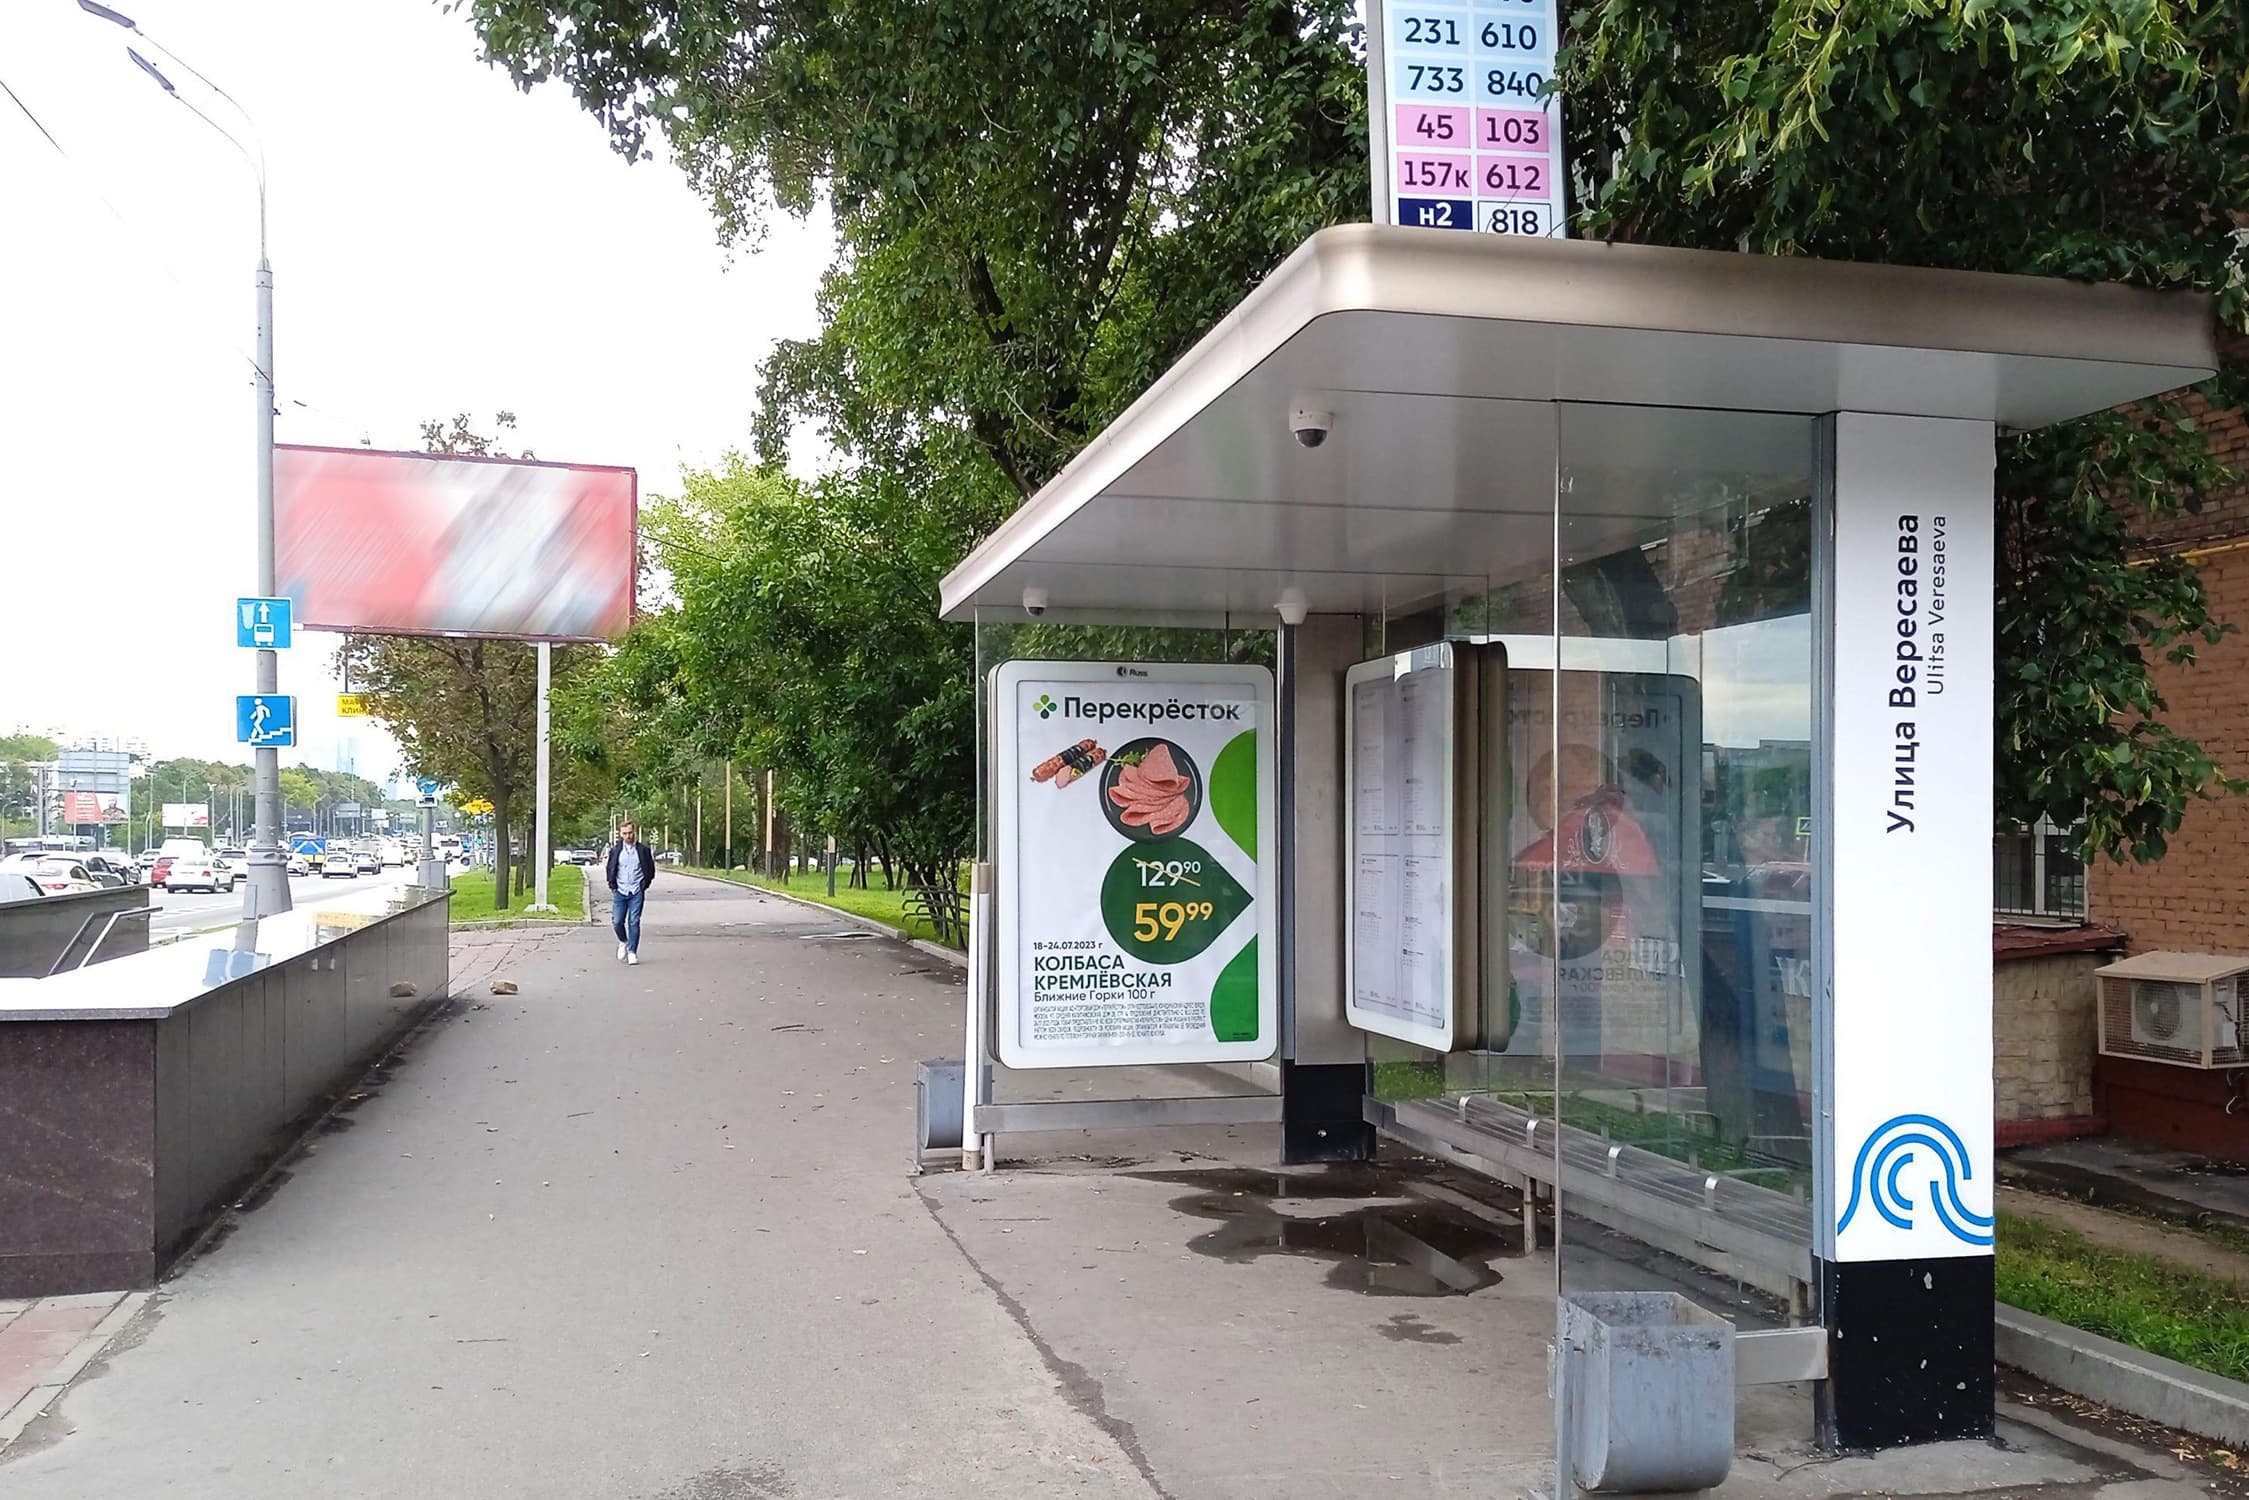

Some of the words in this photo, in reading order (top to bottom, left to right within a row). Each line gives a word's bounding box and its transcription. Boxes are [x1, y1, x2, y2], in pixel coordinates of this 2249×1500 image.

[1404, 17, 1460, 45] 231
[1481, 22, 1537, 50] 610
[1407, 65, 1464, 92] 733
[1487, 70, 1543, 98] 840
[1416, 113, 1454, 140] 45
[1486, 117, 1540, 144] 103
[1404, 160, 1470, 188] 157к
[1486, 164, 1541, 191] 612
[1491, 209, 1539, 234] 818
[1927, 515, 1947, 626] Veresaeva
[1888, 514, 1924, 708] Вересаева
[1926, 632, 1945, 695] Ulitsa
[1064, 696, 1241, 725] Перекрёсток
[1886, 721, 1921, 834] Улица
[1034, 954, 1125, 971] КОЛБАСА
[1034, 970, 1172, 990] КРЕМЛЁВСКАЯ
[1034, 991, 1087, 1002] Ближние
[1089, 989, 1125, 1002] Горки
[1127, 988, 1148, 999] 100
[1150, 989, 1156, 998] г
